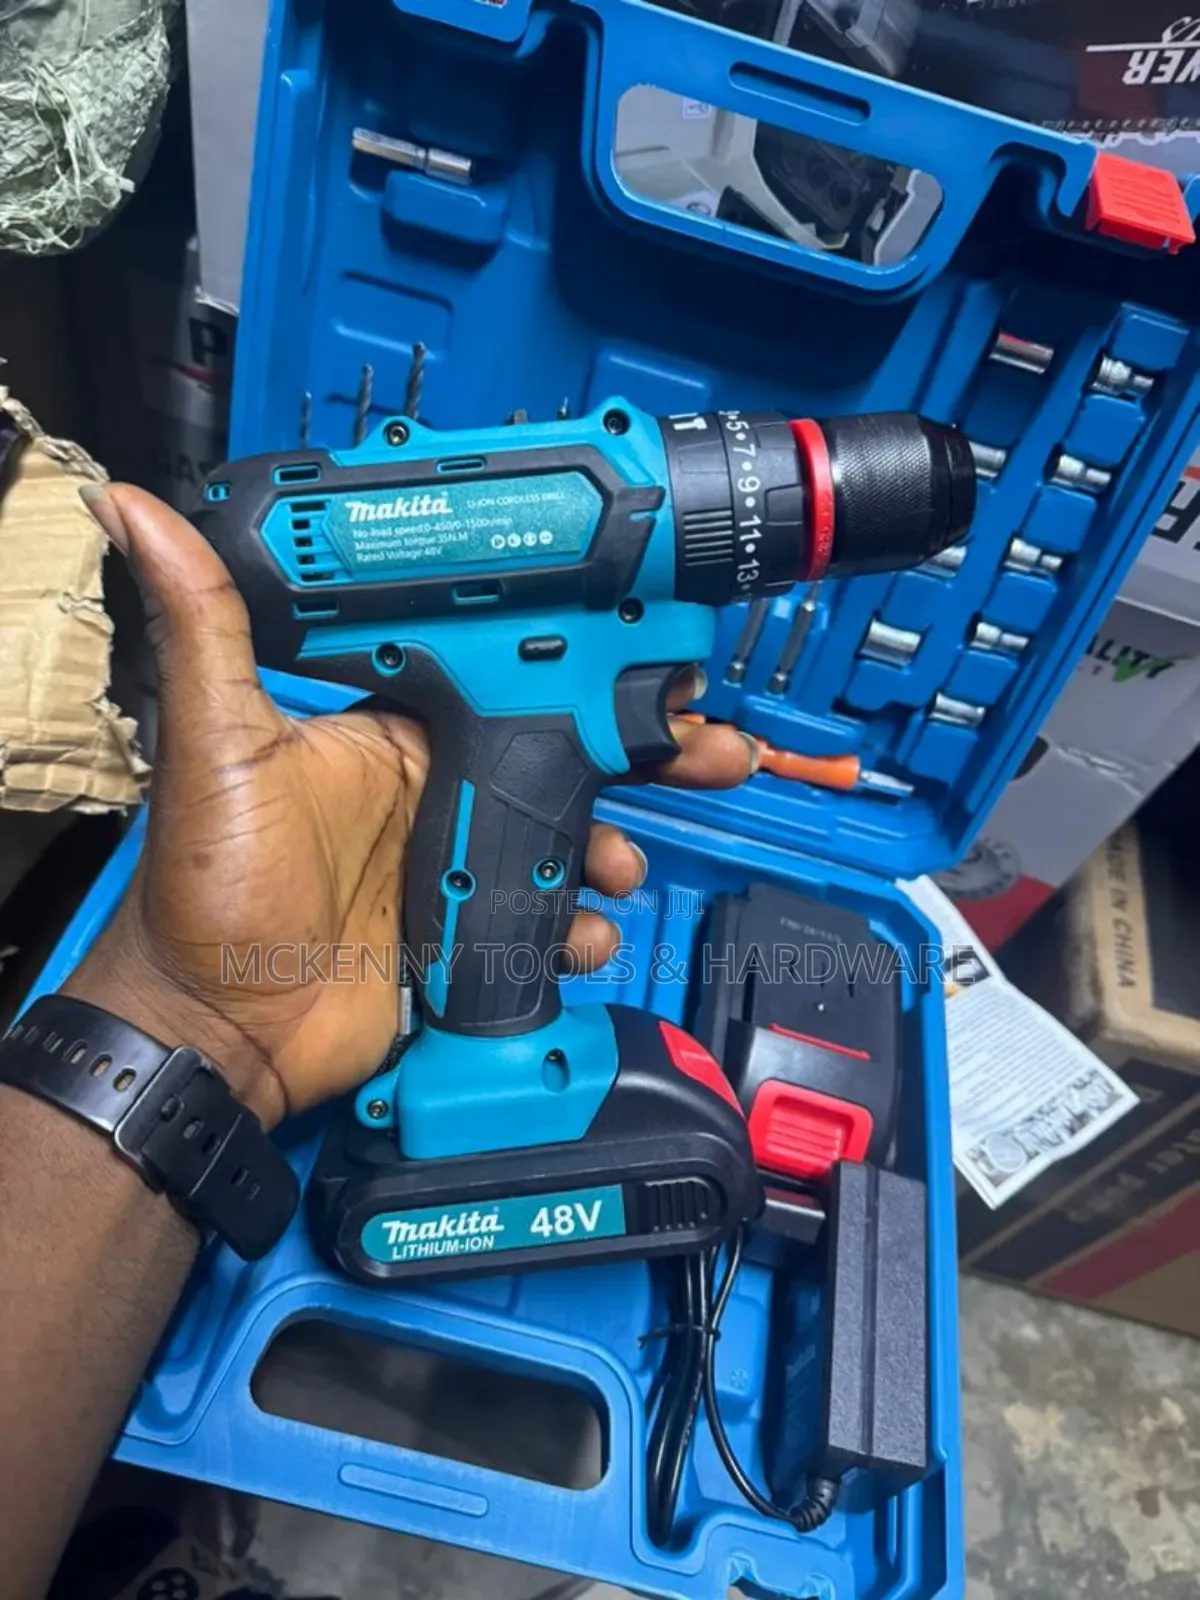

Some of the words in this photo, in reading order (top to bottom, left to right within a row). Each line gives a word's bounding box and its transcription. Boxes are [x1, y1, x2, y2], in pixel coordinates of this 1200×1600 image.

[733, 443, 756, 457] 7
[738, 476, 760, 493] 9
[739, 515, 762, 541] 11
[736, 559, 760, 583] 13
[1110, 886, 1128, 912] IN
[1112, 917, 1137, 989] CHINA
[530, 1200, 602, 1238] 48V
[392, 1235, 495, 1260] LITHIUM-ION
